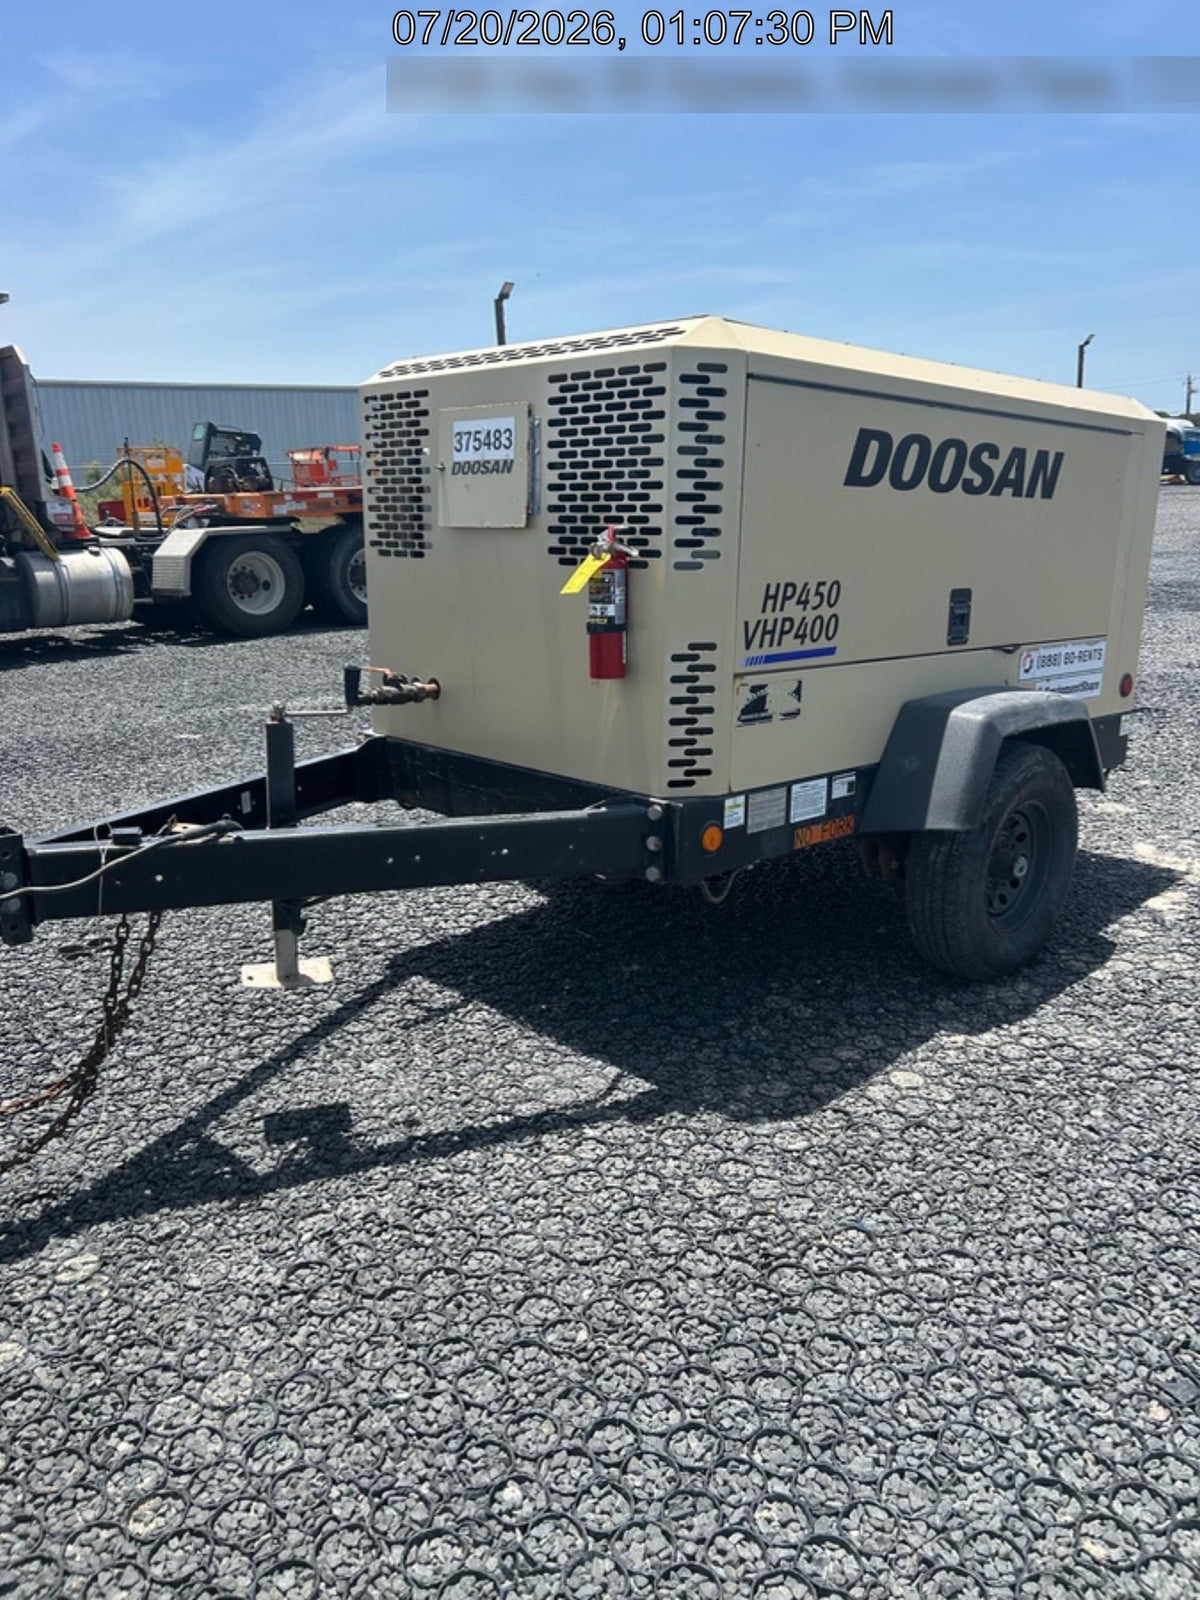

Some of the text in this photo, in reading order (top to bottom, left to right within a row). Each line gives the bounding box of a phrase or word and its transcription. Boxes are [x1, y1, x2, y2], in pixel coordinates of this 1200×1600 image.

[454, 428, 513, 453] 375483
[451, 459, 514, 476] DOOSAN
[843, 428, 1065, 500] DOOSAN
[761, 579, 841, 614] HP450
[743, 613, 839, 651] VHP400
